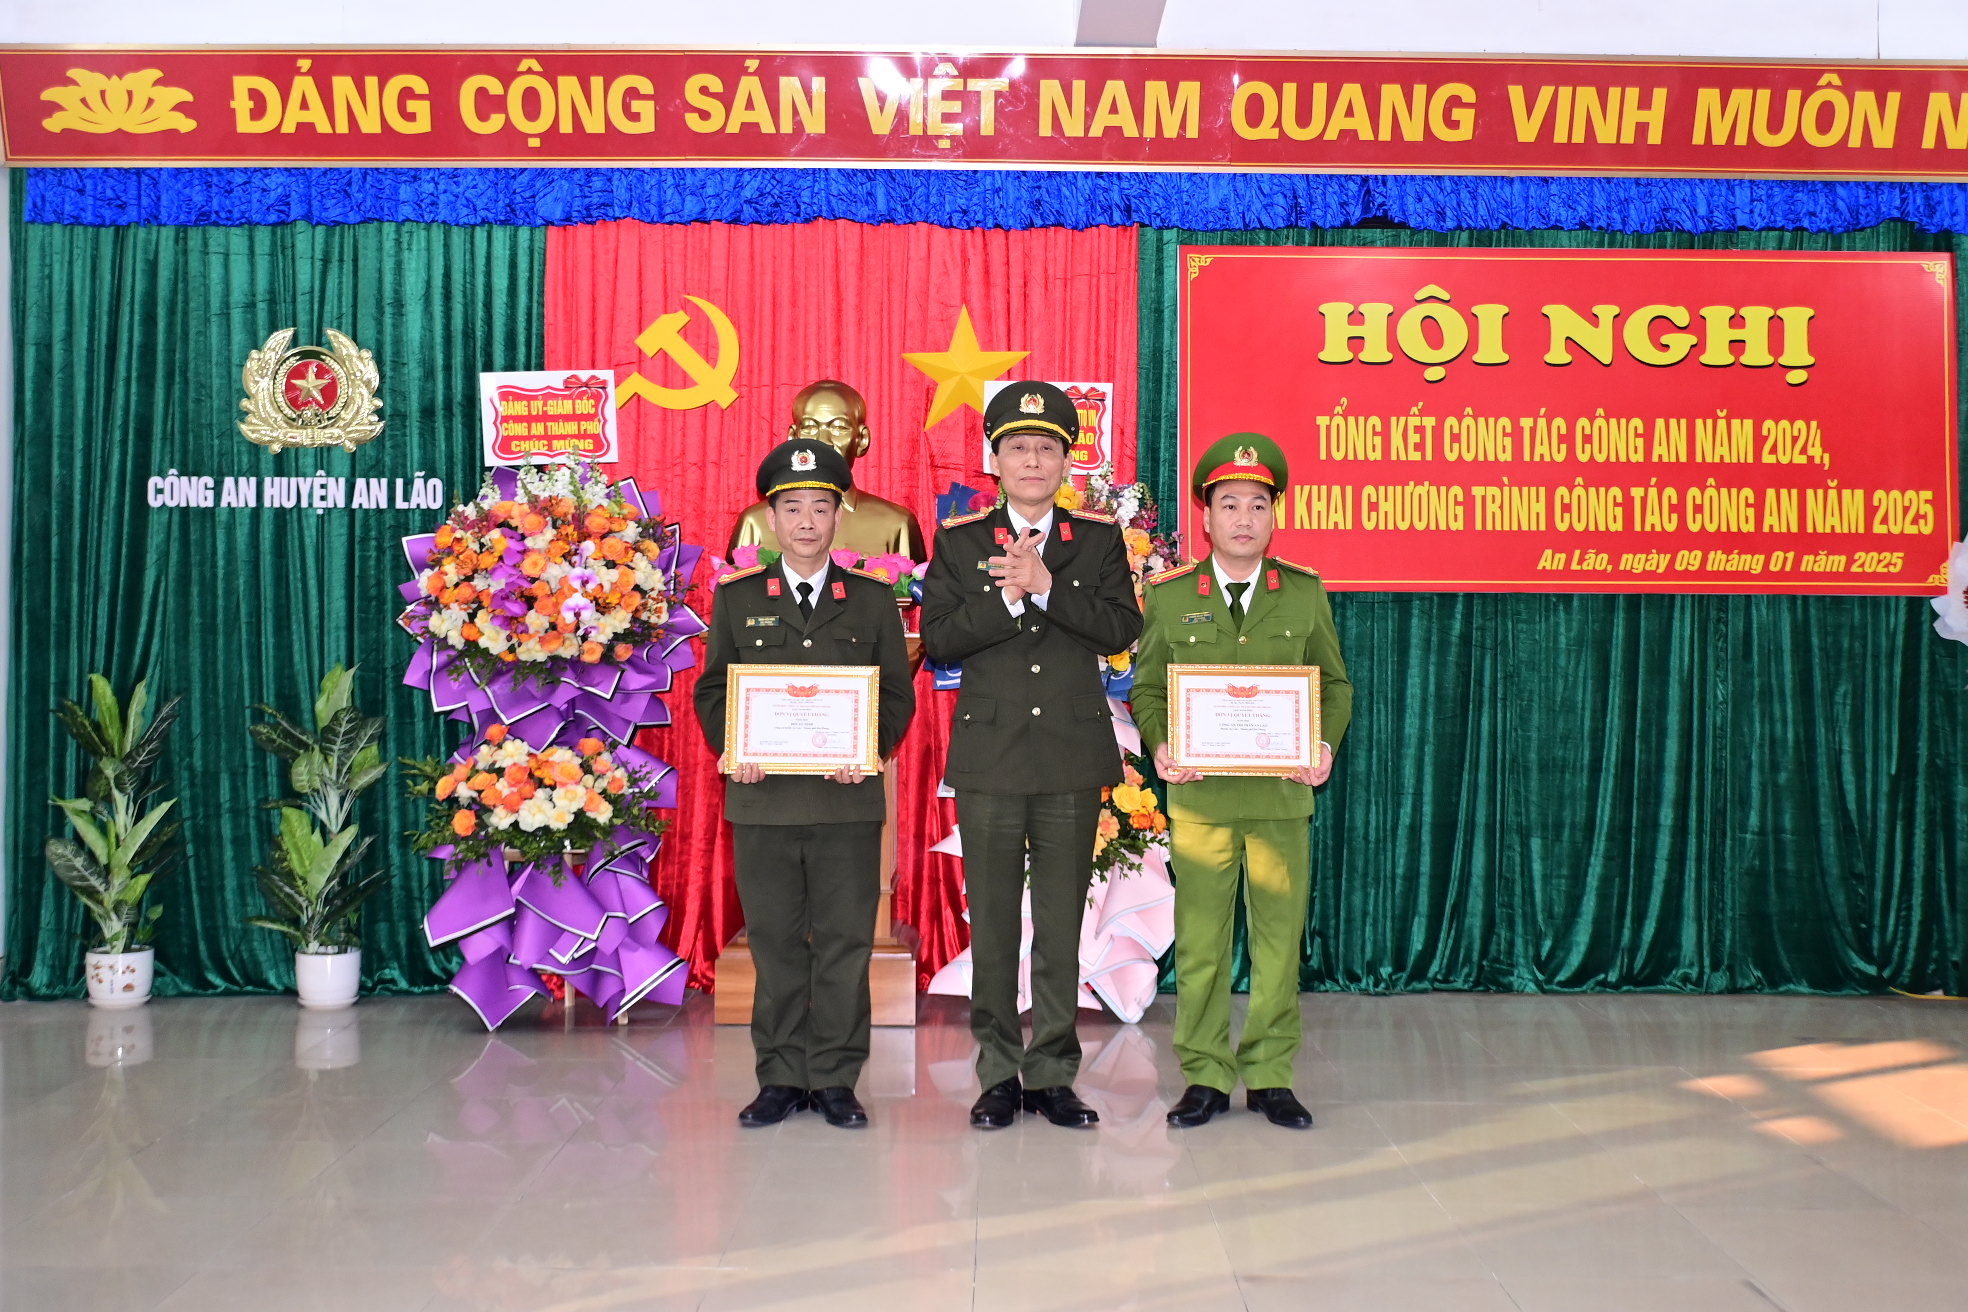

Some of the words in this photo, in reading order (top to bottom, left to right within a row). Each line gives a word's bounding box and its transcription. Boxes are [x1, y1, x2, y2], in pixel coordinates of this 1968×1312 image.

[231, 59, 432, 134] ĐẢNG
[460, 59, 655, 148] CỘNG
[684, 60, 826, 135] SẢN
[858, 63, 1009, 149] VIỆT
[1038, 79, 1201, 139] NAM
[1231, 81, 1477, 142] QUANG
[1508, 85, 1668, 145] VINH
[1692, 73, 1906, 149] MUÔN
[1317, 284, 1511, 382] HỘI
[1542, 303, 1817, 386] NGHỊ
[501, 396, 529, 417] ĐẢNG
[575, 394, 596, 415] ĐỐC
[502, 420, 529, 437] CÔNG
[530, 422, 546, 436] AN
[547, 419, 579, 436] THÀNH
[580, 416, 601, 435] PHỐ
[1074, 430, 1095, 445] ÃO
[1316, 397, 1382, 462] TỔNG
[1391, 401, 1437, 462] KẾT
[1444, 407, 1513, 463] CÔNG
[1520, 408, 1568, 463] TÁC
[1576, 407, 1645, 464] CÔNG
[1653, 419, 1688, 464] AN
[1696, 408, 1755, 464] NĂM
[1762, 420, 1831, 471] 2024,
[511, 438, 549, 452] CHÚC
[147, 468, 215, 509] CÔNG
[220, 477, 257, 508] AN
[263, 470, 346, 514] HUYỆN
[352, 477, 389, 509] AN
[396, 471, 444, 510] LÃO
[1295, 485, 1353, 530] KHAI
[1362, 481, 1465, 532] CHƯƠNG
[1472, 476, 1547, 532] TRÌNH
[1555, 477, 1624, 533] CÔNG
[1631, 478, 1679, 533] TÁC
[1687, 478, 1756, 534] CÔNG
[1763, 489, 1800, 534] AN
[1807, 479, 1866, 535] NĂM
[1874, 490, 1935, 536] 2025
[1538, 550, 1568, 571] An
[1572, 550, 1613, 574] Lão,
[1620, 551, 1672, 575] ngày
[1676, 550, 1703, 572] 09
[1707, 550, 1766, 575] tháng
[1770, 551, 1795, 573] 01
[1801, 551, 1848, 573] năm
[1852, 552, 1905, 573] 2025
